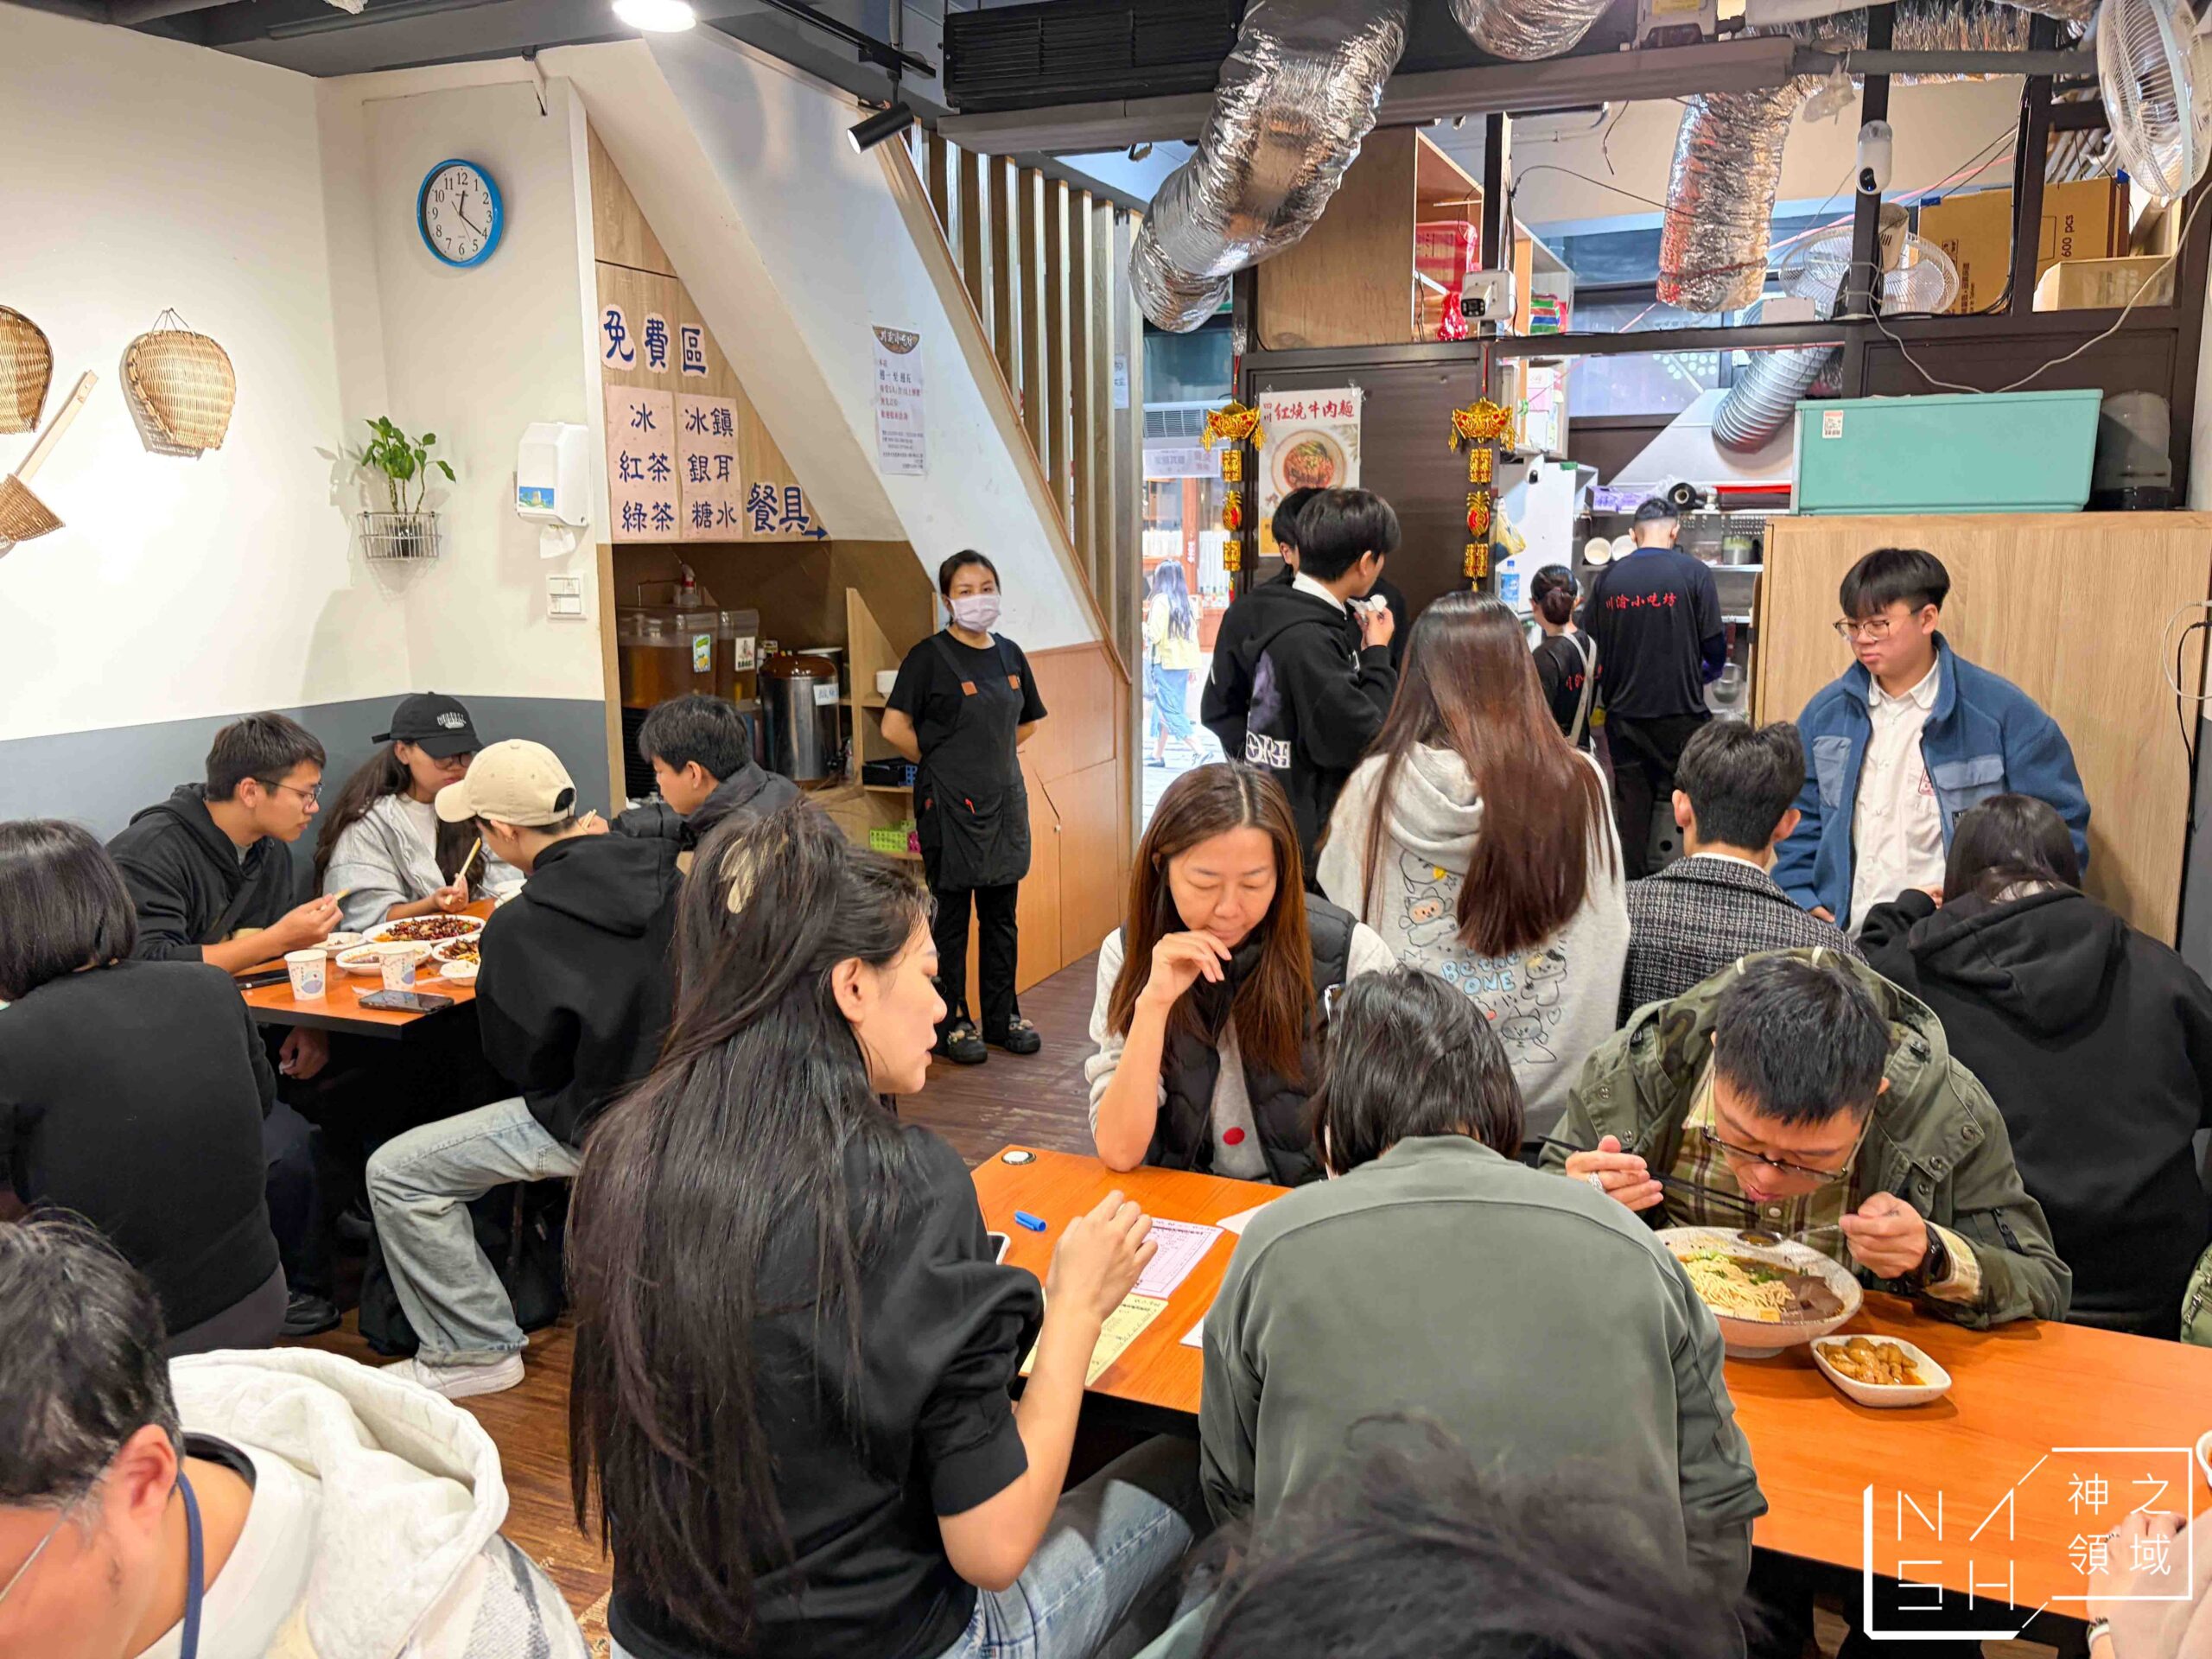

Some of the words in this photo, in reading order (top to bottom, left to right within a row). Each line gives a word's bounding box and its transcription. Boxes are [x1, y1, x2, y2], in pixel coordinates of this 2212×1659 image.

[444, 176, 454, 191] 11
[457, 172, 468, 186] 12
[474, 178, 478, 192] 1
[435, 189, 445, 203] 10
[482, 191, 489, 205] 2
[432, 207, 439, 220] 9
[486, 210, 493, 224] 3
[435, 224, 442, 238] 8
[2065, 214, 2074, 232] pcs
[481, 226, 488, 240] 4
[445, 237, 452, 250] 7
[458, 242, 465, 256] 6
[472, 238, 479, 252] 5
[2062, 237, 2072, 257] 600
[603, 310, 707, 375] 免費區
[629, 404, 657, 434] 冰
[684, 406, 734, 437] 冰鎮
[619, 450, 671, 484] 紅茶
[687, 453, 734, 484] 銀耳
[691, 500, 737, 530] 糖水
[747, 482, 810, 533] 餐具
[621, 499, 675, 534] 綠茶
[1605, 592, 1677, 610] 川渝小吃坊
[1463, 969, 1516, 995] ONE
